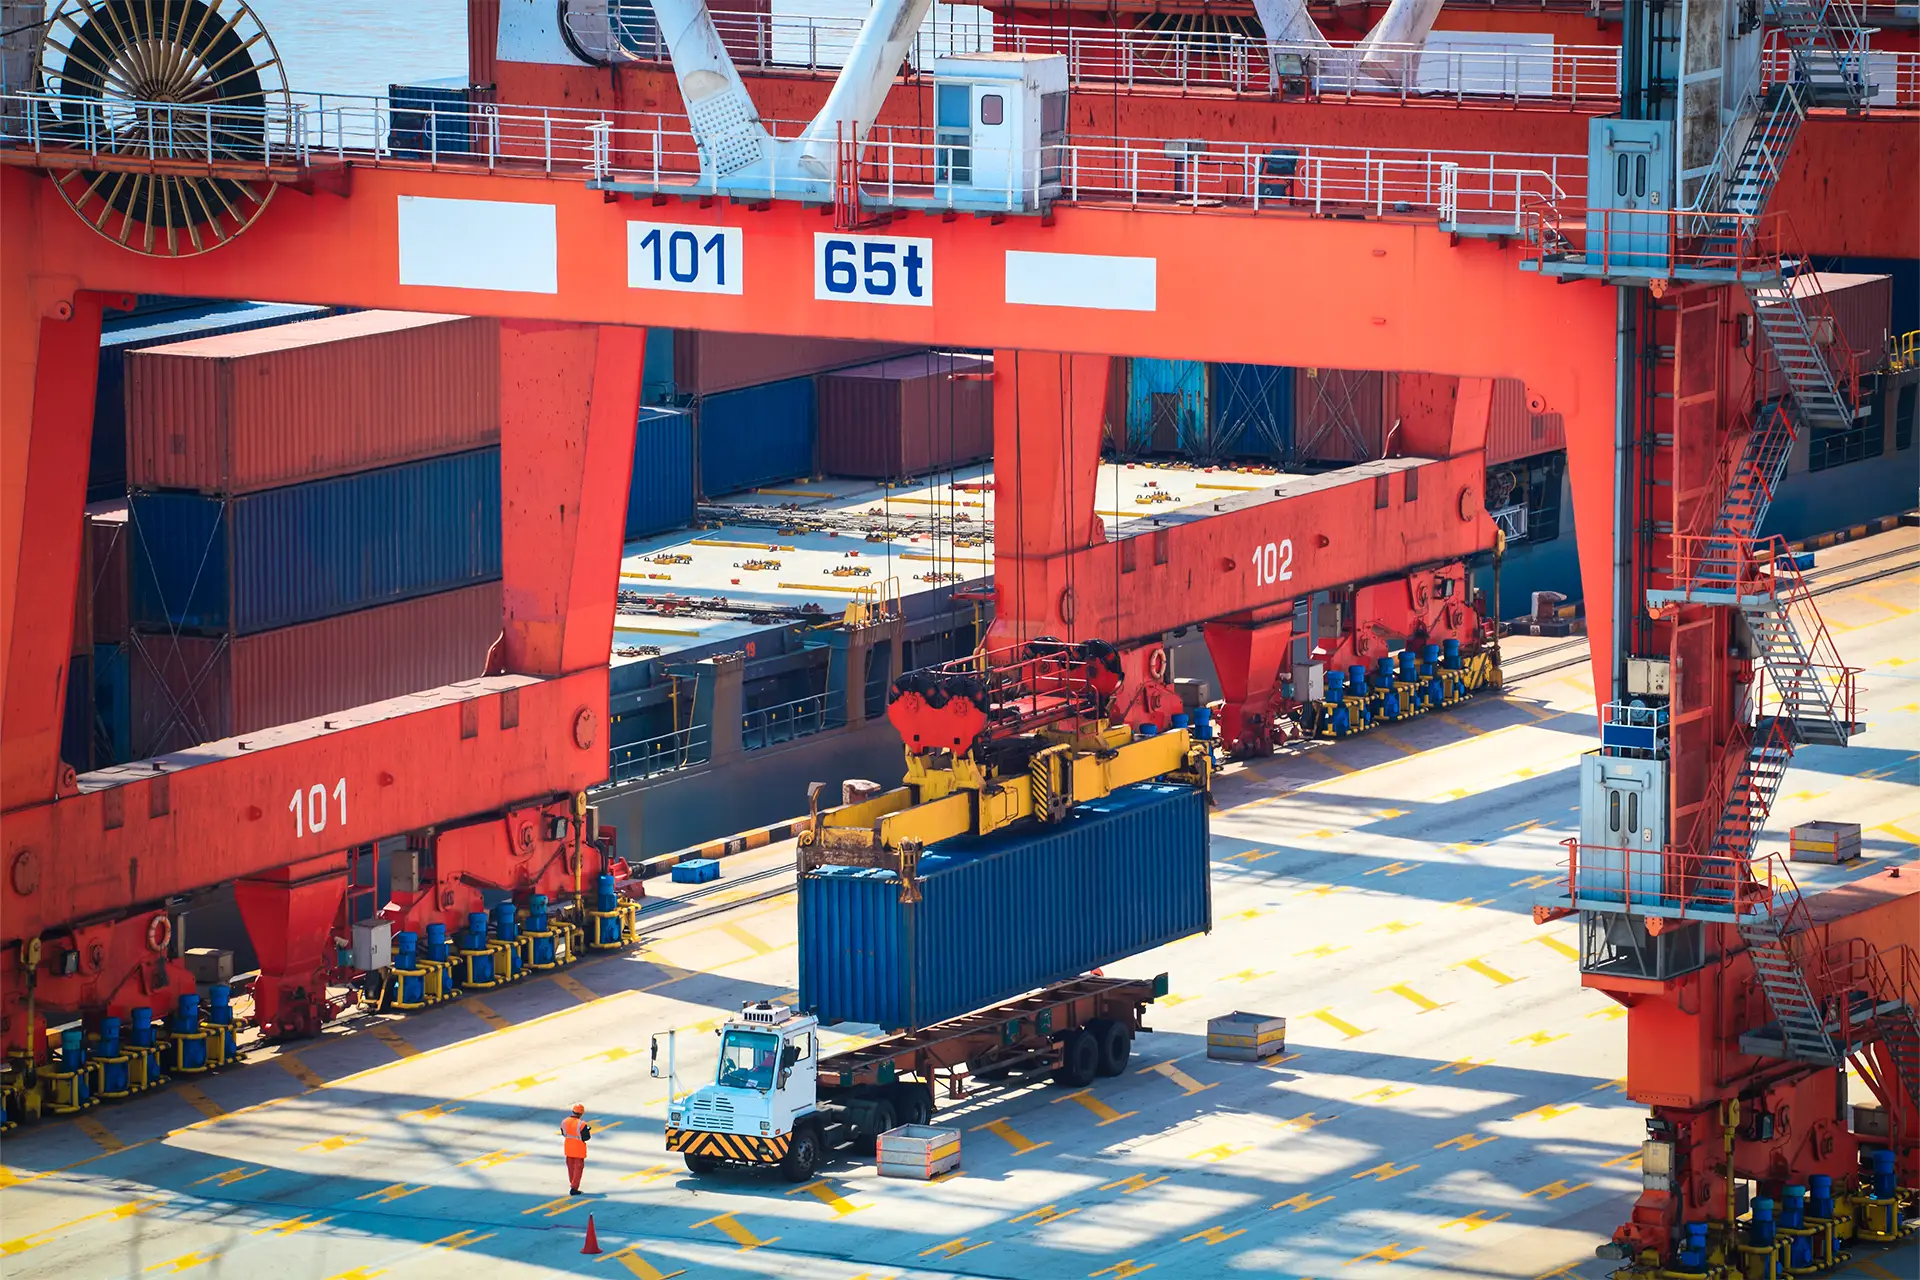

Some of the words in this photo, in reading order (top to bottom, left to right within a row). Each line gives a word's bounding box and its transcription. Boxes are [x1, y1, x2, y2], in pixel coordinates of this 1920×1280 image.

[641, 228, 725, 286] 101
[825, 240, 923, 298] 65t
[1251, 538, 1293, 587] 102
[288, 777, 347, 838] 101
